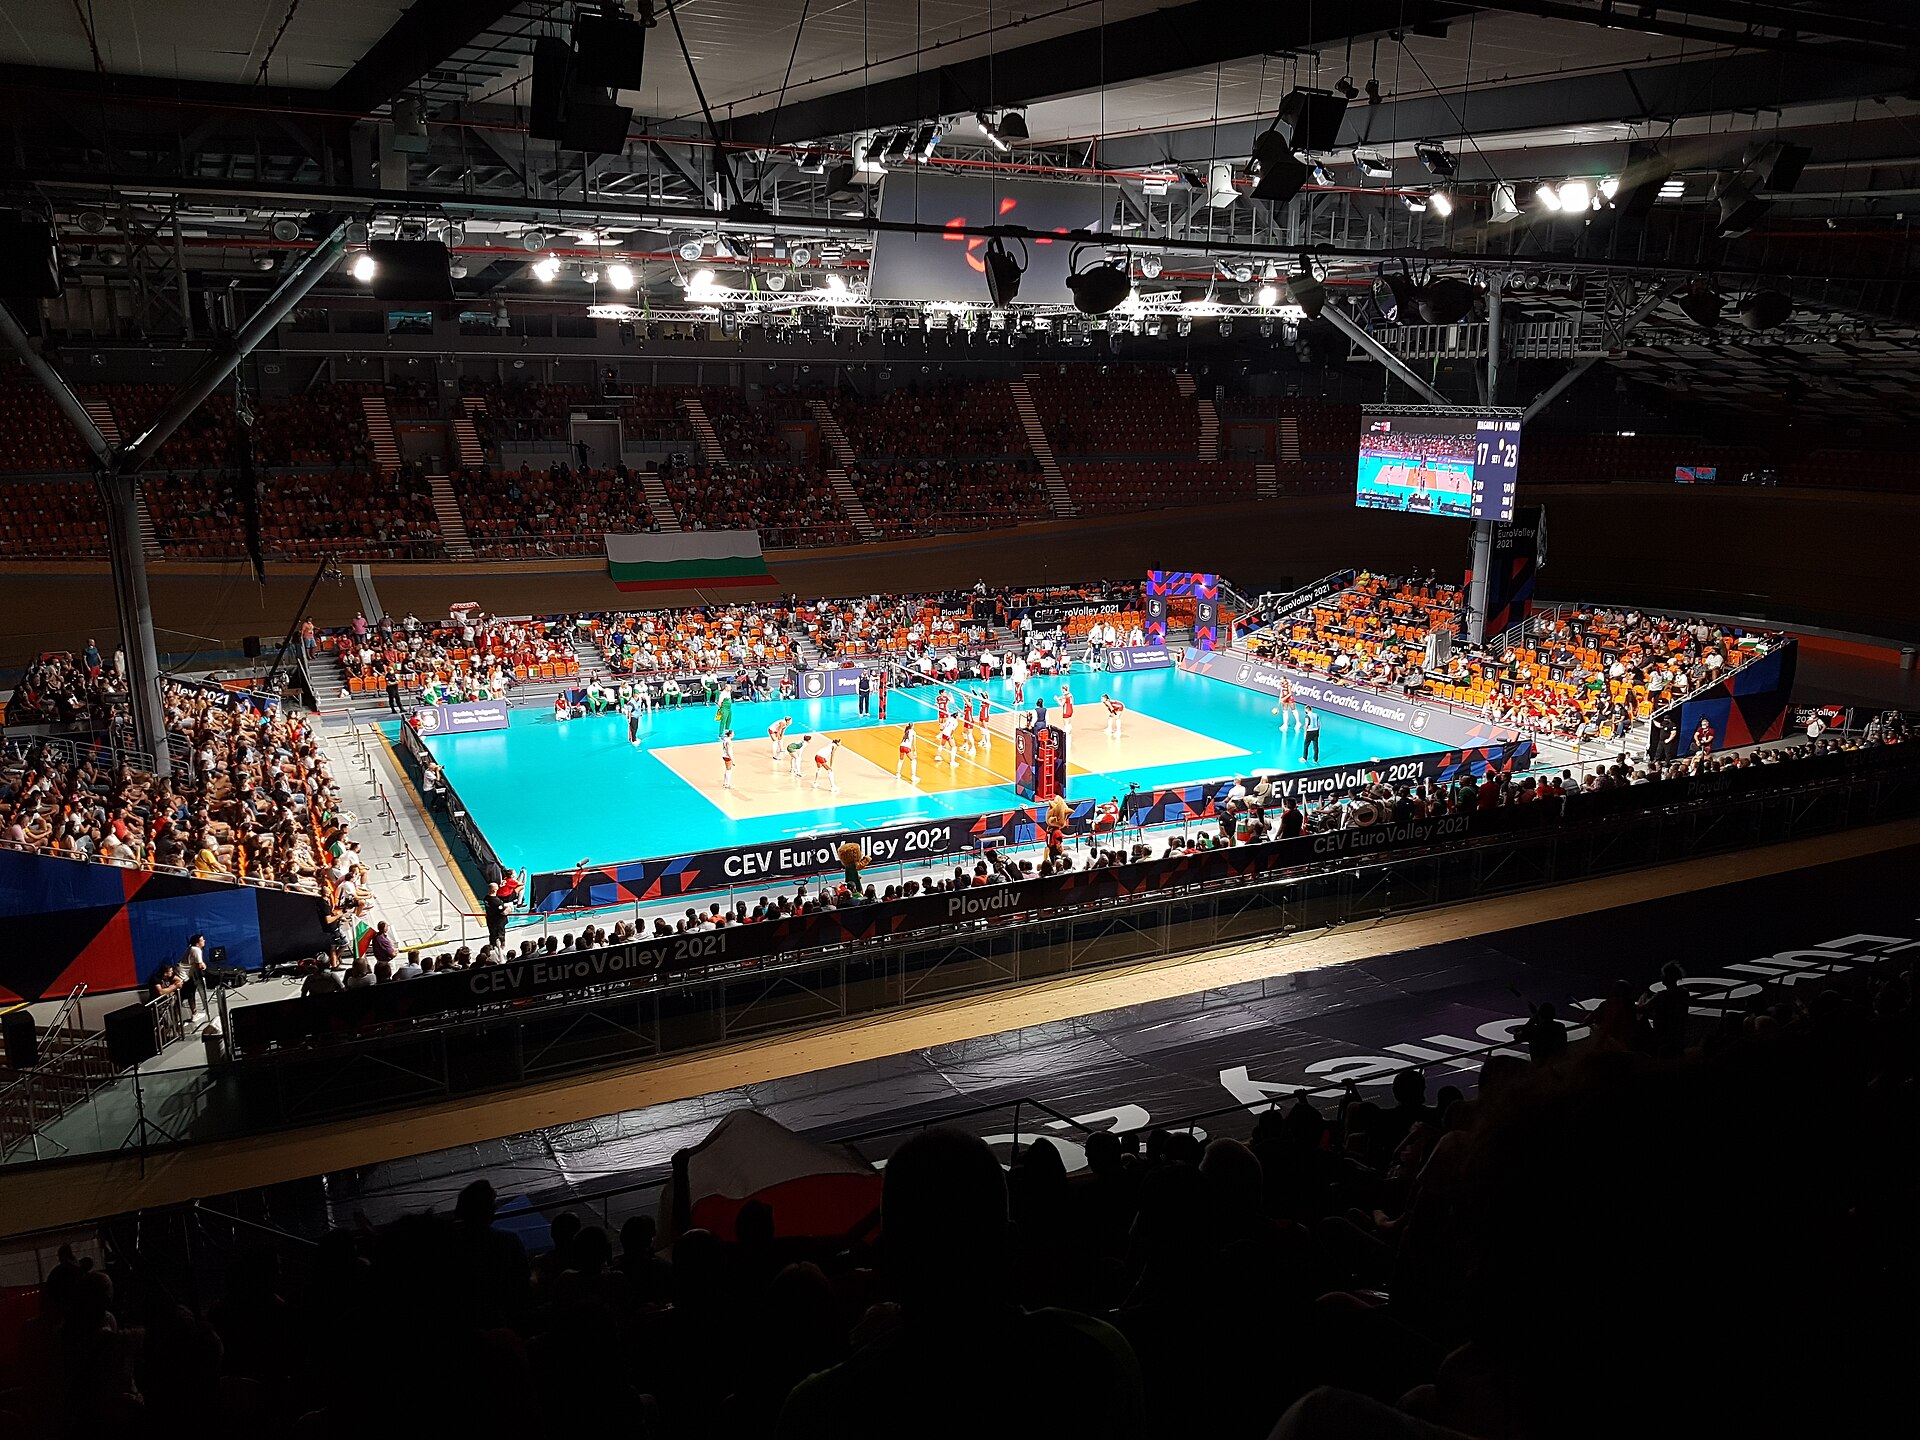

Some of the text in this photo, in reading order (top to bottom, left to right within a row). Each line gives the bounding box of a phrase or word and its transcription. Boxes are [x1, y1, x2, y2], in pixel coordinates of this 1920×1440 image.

[1477, 442, 1489, 465] 17
[1503, 444, 1517, 468] 23
[1496, 540, 1513, 549] 2021
[1498, 528, 1535, 539] EuroVolley
[941, 608, 966, 617] Plovdiv
[1100, 604, 1119, 614] 2021
[1277, 593, 1313, 615] EuroVolley
[1313, 584, 1331, 598] 2021
[961, 626, 986, 634] Plodiv
[1323, 690, 1360, 711] Croatia,
[1361, 700, 1405, 722] Romania
[1272, 761, 1424, 798] EV EuroVolly 2021
[1313, 815, 1470, 855] CEV EuroVolley 2021
[724, 826, 951, 878] CEV EuroVlley 2021
[948, 888, 1021, 917] Plovdiv
[469, 933, 727, 995] CEV EuroVolley 2021
